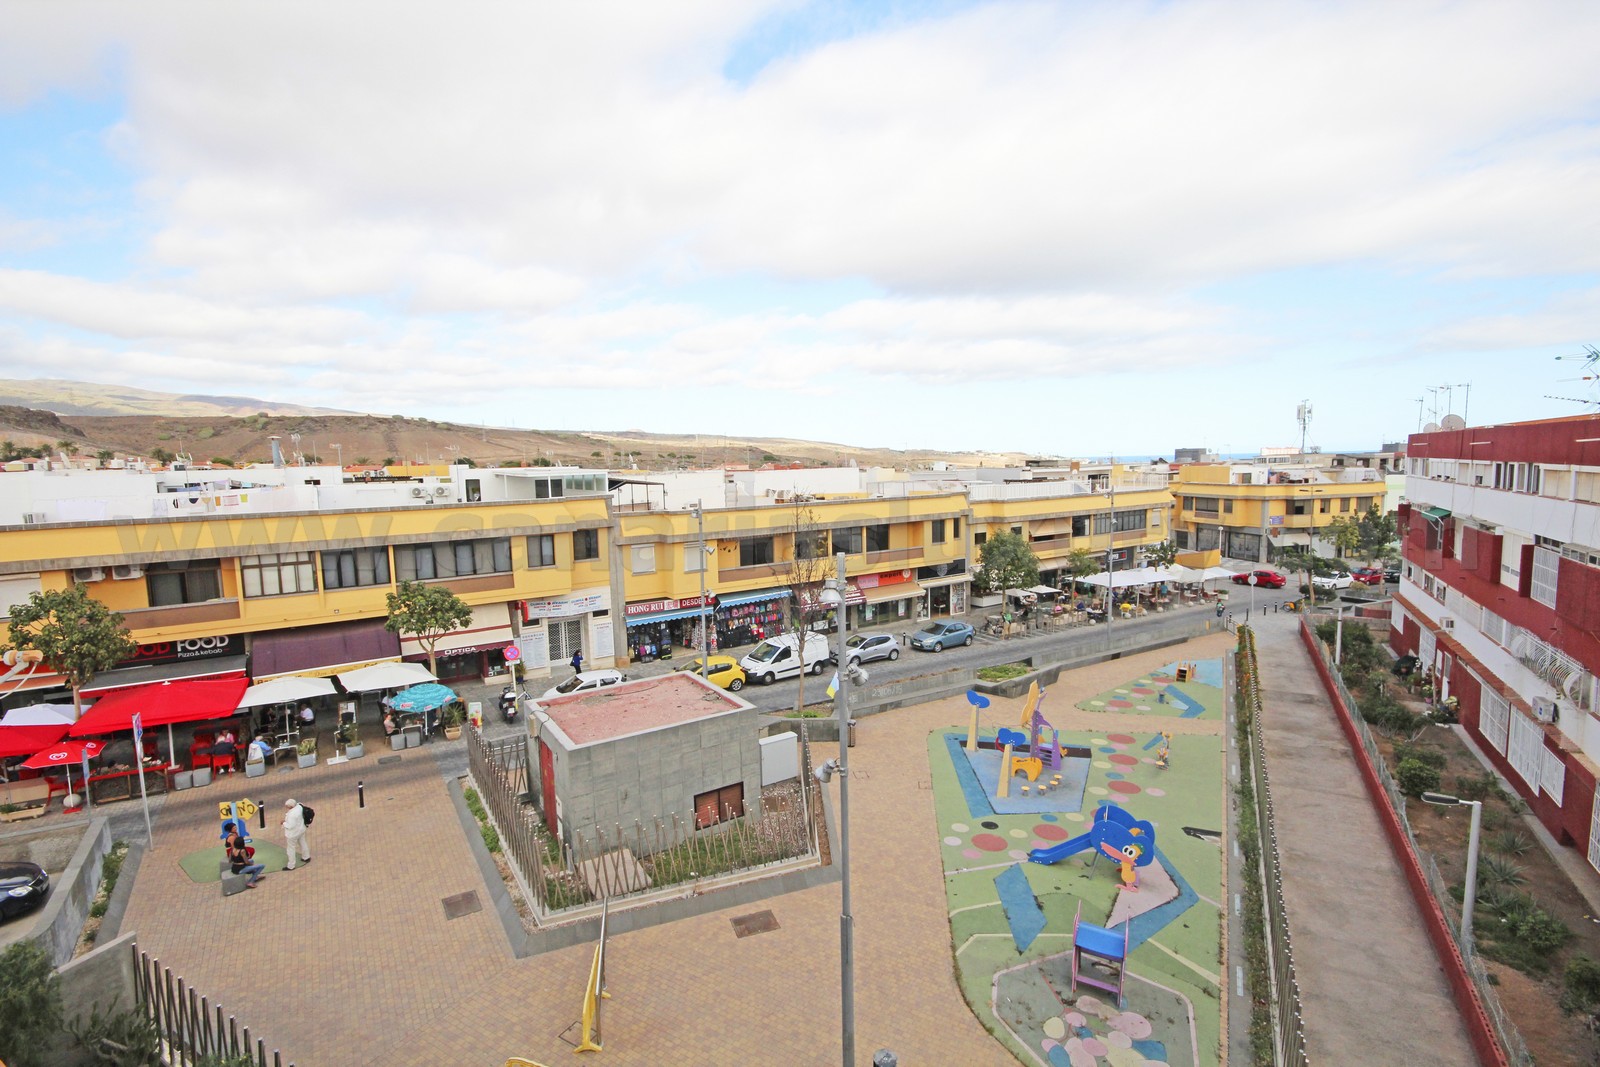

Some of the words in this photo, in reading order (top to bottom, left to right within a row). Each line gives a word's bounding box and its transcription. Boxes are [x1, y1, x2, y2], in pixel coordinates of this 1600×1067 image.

[628, 604, 649, 614] HONG
[650, 602, 664, 611] RUI
[177, 635, 229, 652] FOOD
